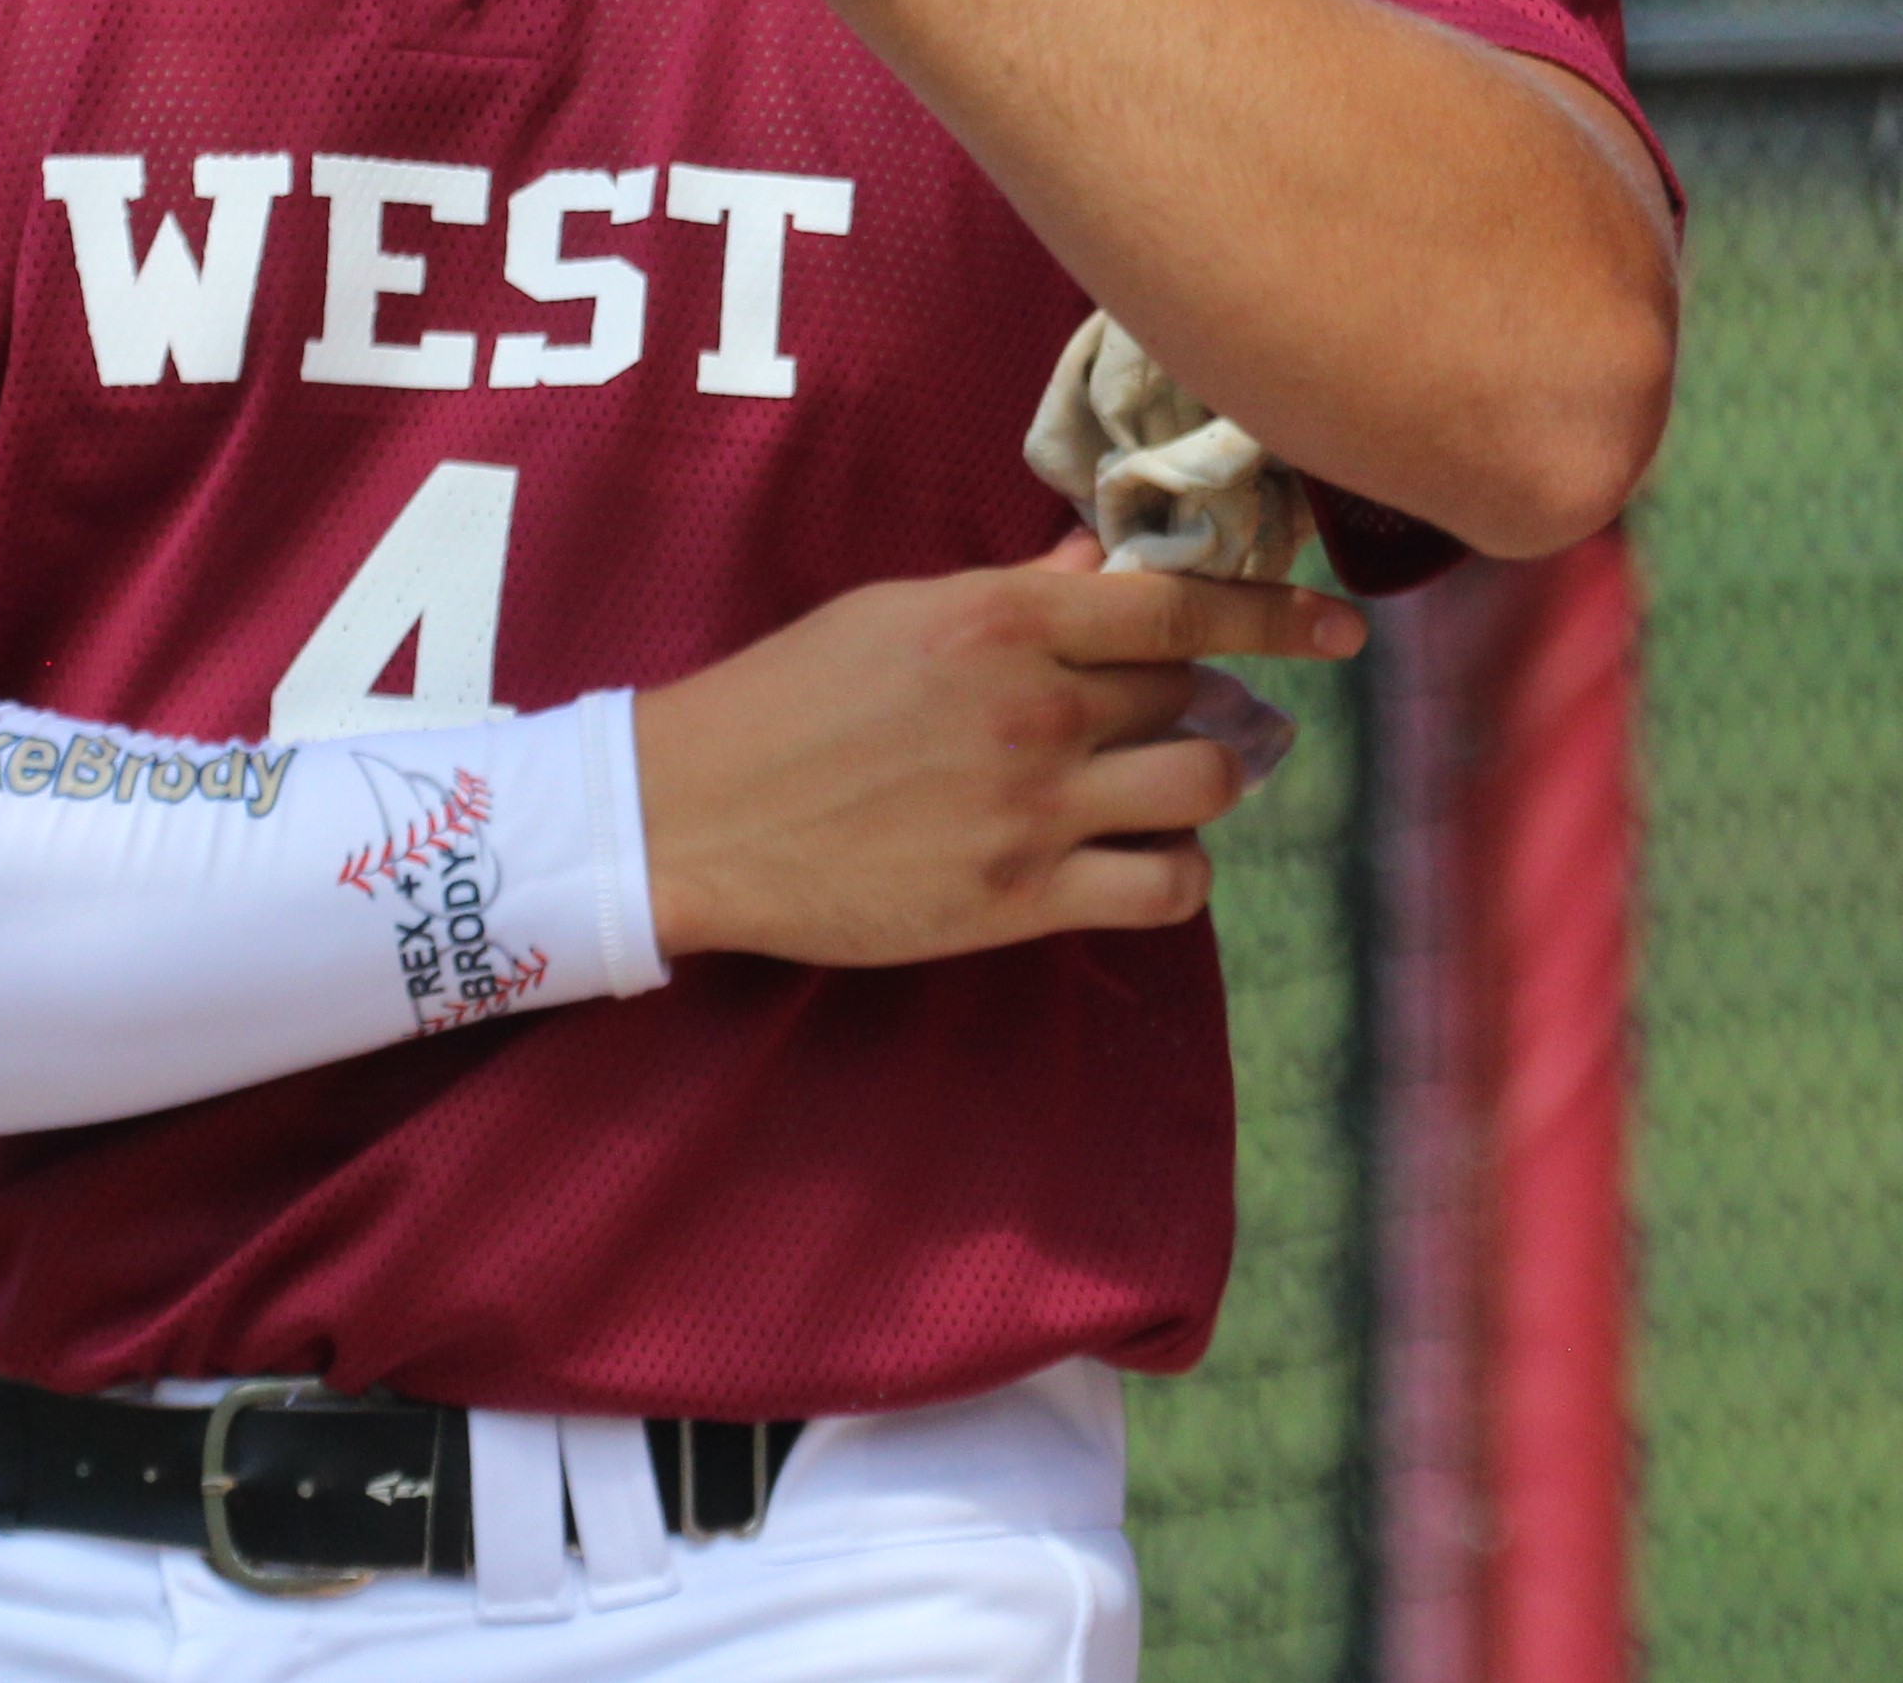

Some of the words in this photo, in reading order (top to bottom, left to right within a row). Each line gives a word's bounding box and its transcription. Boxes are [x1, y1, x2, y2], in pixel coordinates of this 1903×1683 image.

[41, 150, 855, 399] WEST
[271, 459, 518, 746] 4
[396, 915, 443, 1000] REX
[442, 848, 496, 1002] BRODY
